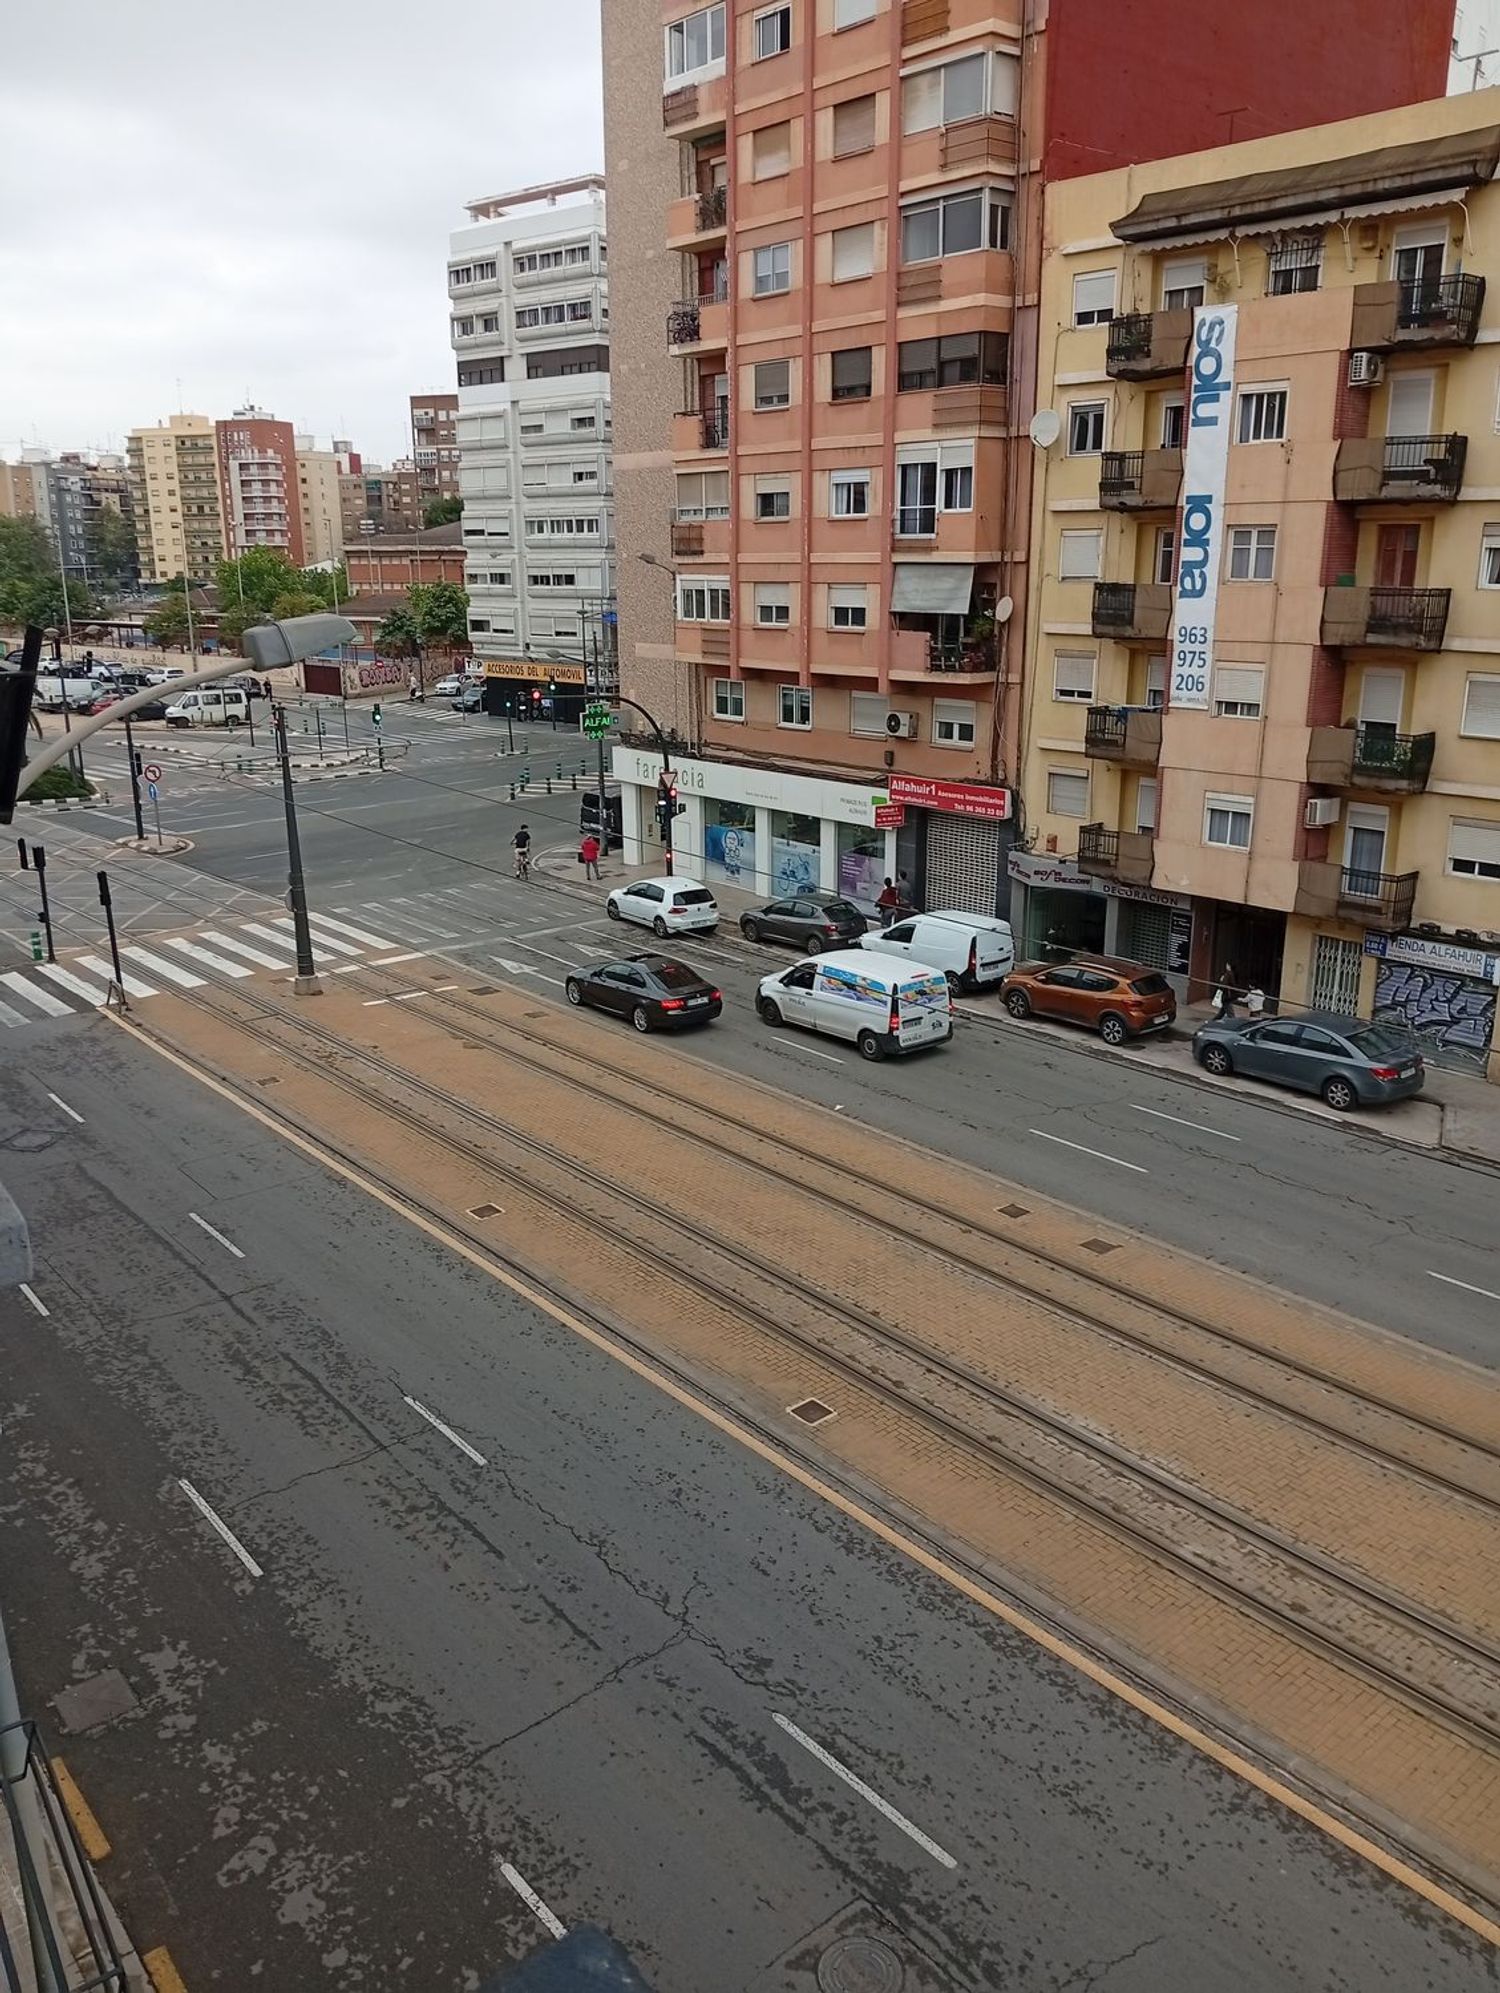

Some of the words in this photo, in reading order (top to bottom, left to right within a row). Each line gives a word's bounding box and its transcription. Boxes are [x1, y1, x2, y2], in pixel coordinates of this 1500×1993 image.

[1178, 626, 1208, 644] 963
[1177, 650, 1207, 668] 975
[487, 663, 525, 676] ACCESORIOS
[528, 665, 539, 677] DEL
[1175, 673, 1205, 692] 206
[636, 757, 705, 789] faracia
[1429, 944, 1483, 965] ALFAHUIR
